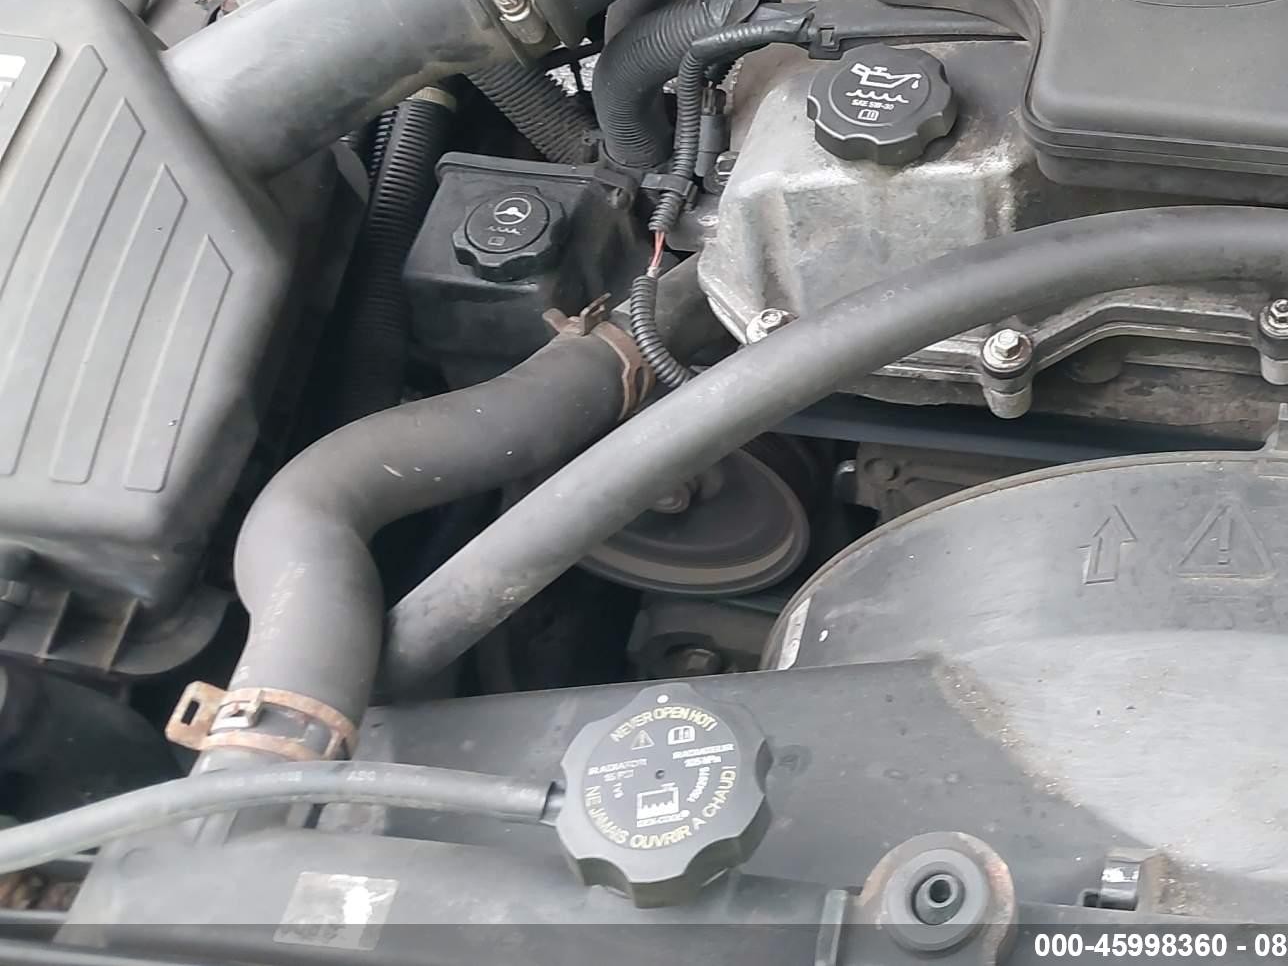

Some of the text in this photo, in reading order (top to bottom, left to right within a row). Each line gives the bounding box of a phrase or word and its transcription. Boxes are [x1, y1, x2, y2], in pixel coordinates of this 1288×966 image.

[610, 711, 654, 742] NEVER
[653, 706, 689, 720] OPEN
[588, 759, 648, 775] RADIATOR
[584, 786, 602, 807] NE
[589, 808, 630, 845] JAMAIS
[630, 825, 692, 849] OUVRIR
